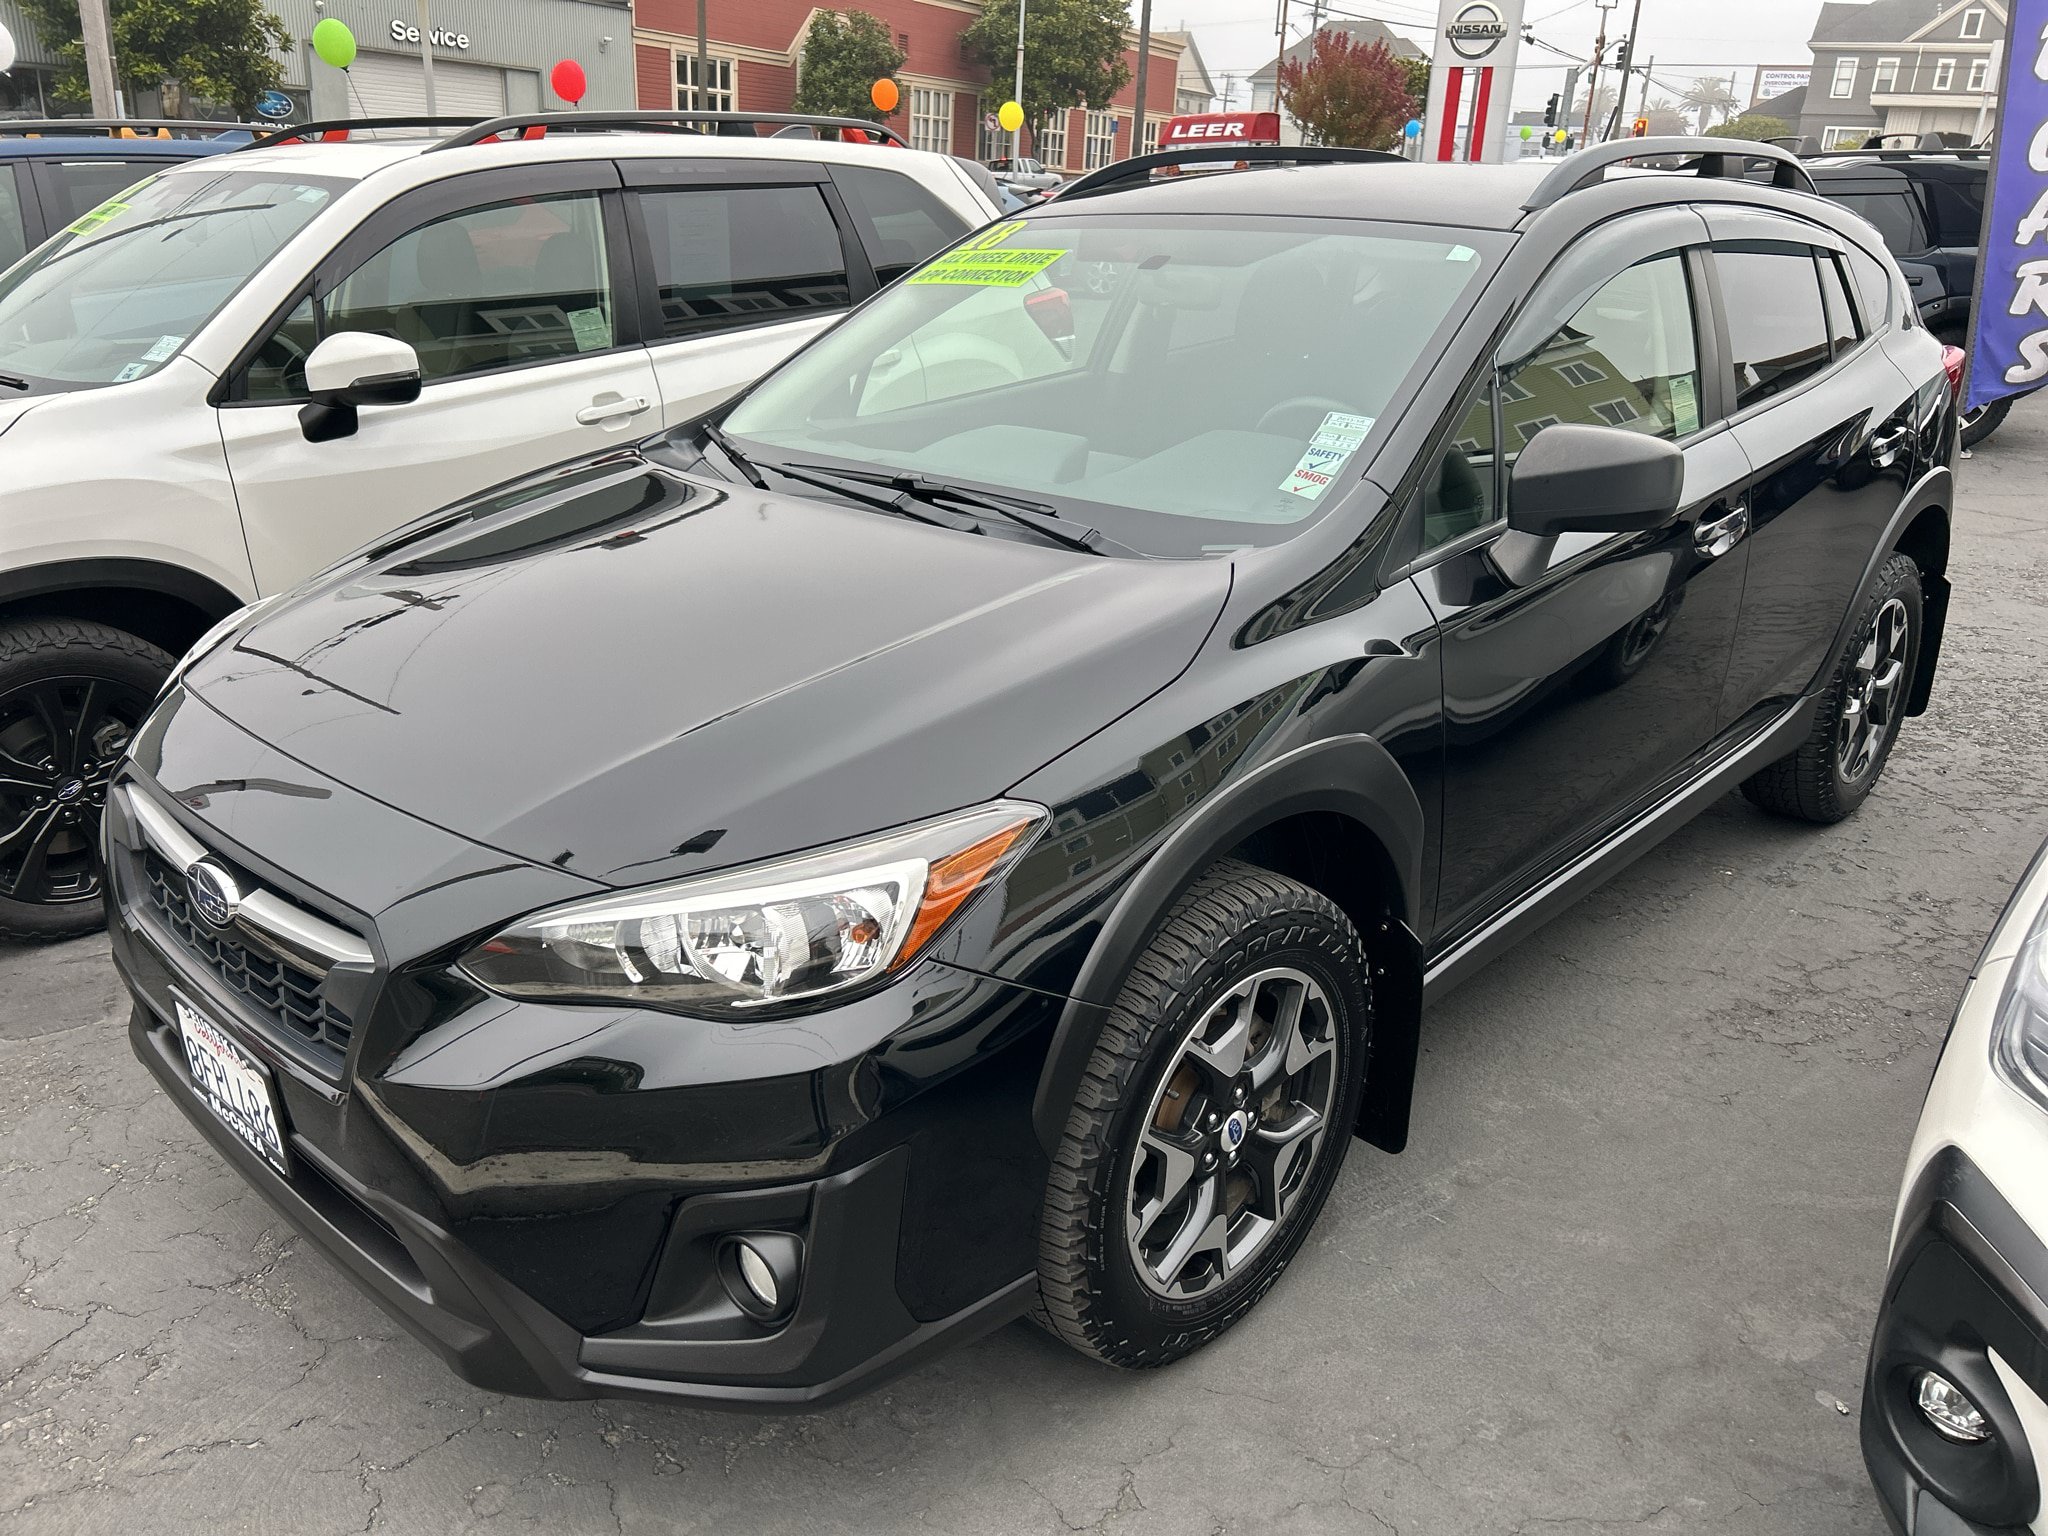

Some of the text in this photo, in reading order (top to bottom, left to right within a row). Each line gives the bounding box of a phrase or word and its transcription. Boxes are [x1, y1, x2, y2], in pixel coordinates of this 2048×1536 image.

[390, 19, 470, 49] Sevice
[1450, 24, 1501, 35] NISSAN
[1171, 123, 1245, 138] LEER
[941, 252, 1060, 266] ALL WHEEL DRIVE
[938, 269, 1035, 284] CONNECTION
[1308, 448, 1345, 461] SAFETY
[1294, 469, 1329, 485] SMOG
[186, 1035, 279, 1151] 8FPL486
[209, 1093, 267, 1158] McCREA
